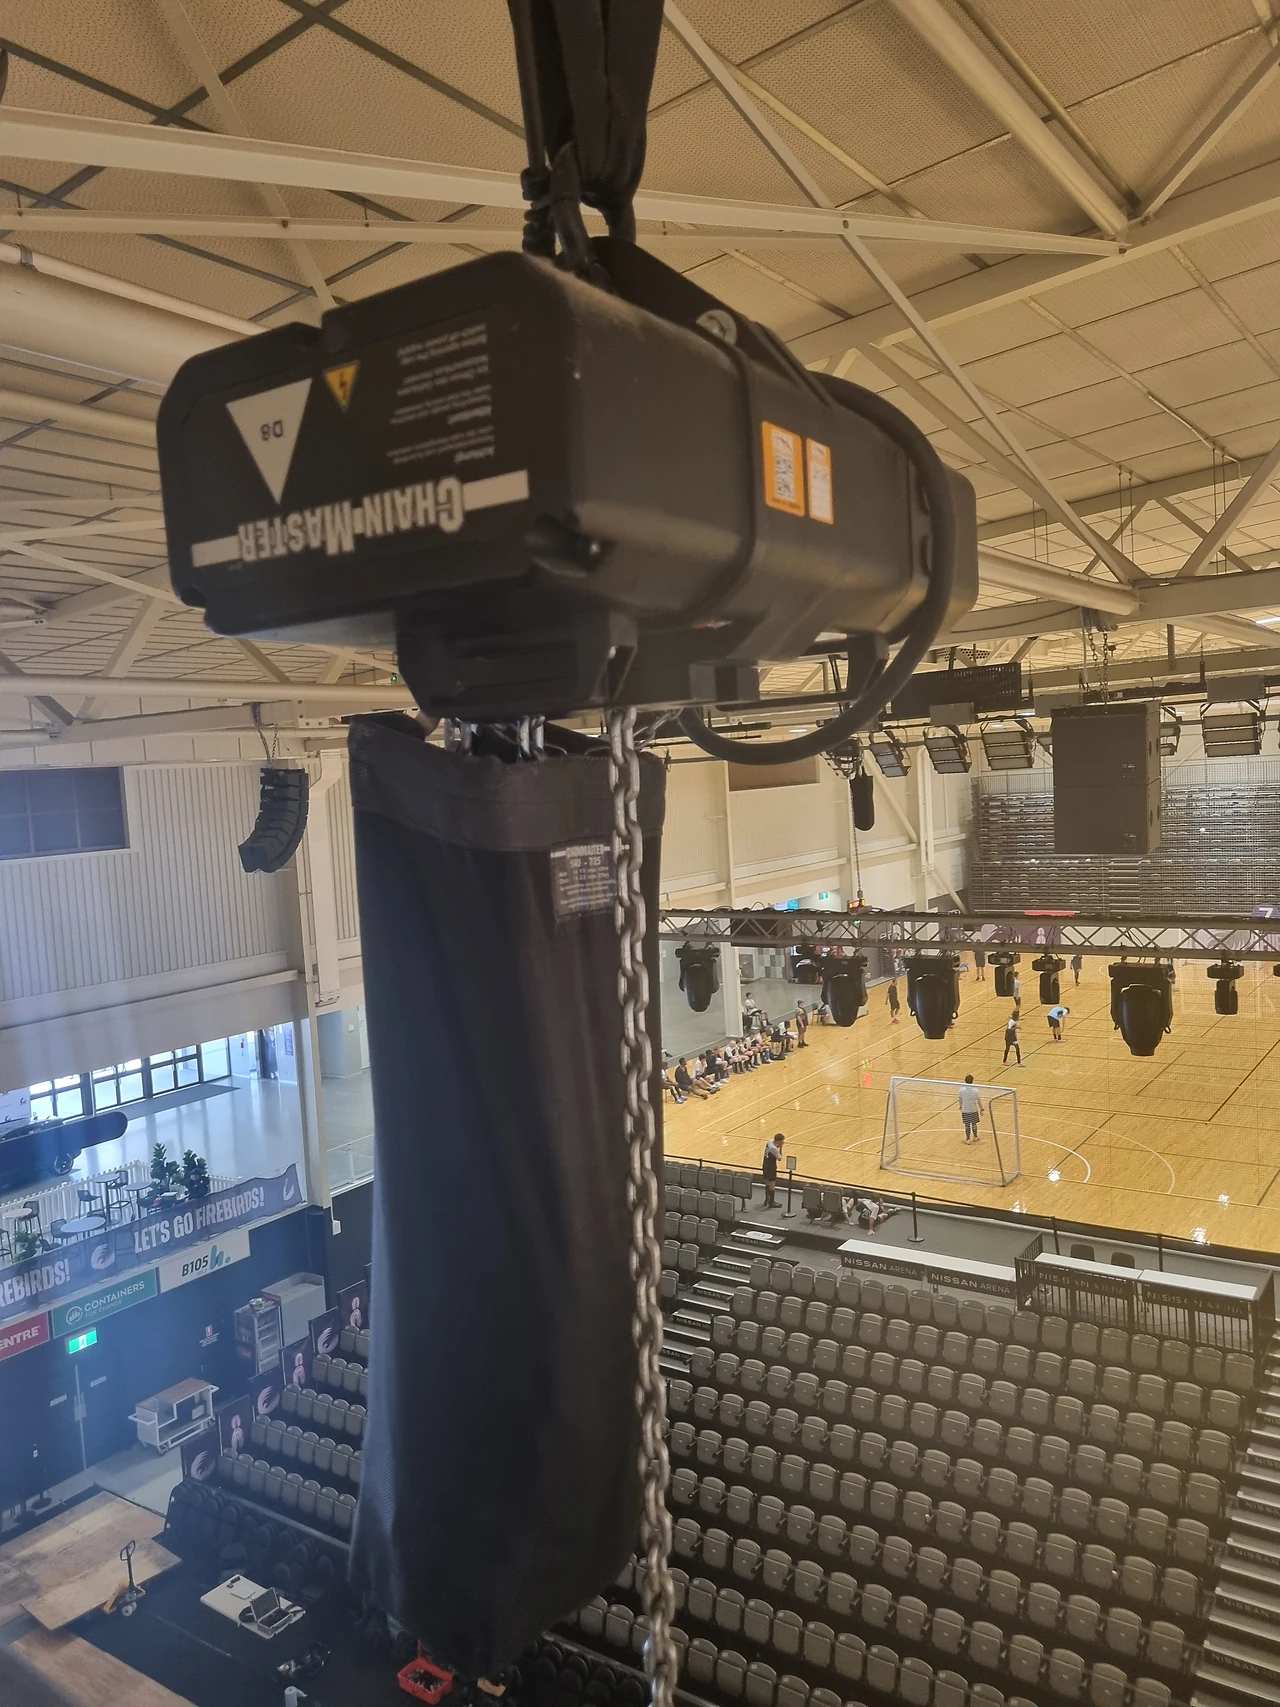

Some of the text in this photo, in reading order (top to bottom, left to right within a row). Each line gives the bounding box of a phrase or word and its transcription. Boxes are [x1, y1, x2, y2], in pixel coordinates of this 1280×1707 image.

[133, 1186, 265, 1254] LET'S GO FIREBIRDS!
[181, 1254, 209, 1277] B105
[844, 1256, 917, 1276] NISSAN ARENA
[931, 1273, 1011, 1294] NISSAN ARENA
[84, 1280, 146, 1312] CONTAINERS
[85, 1299, 123, 1318] FOR CHANGE
